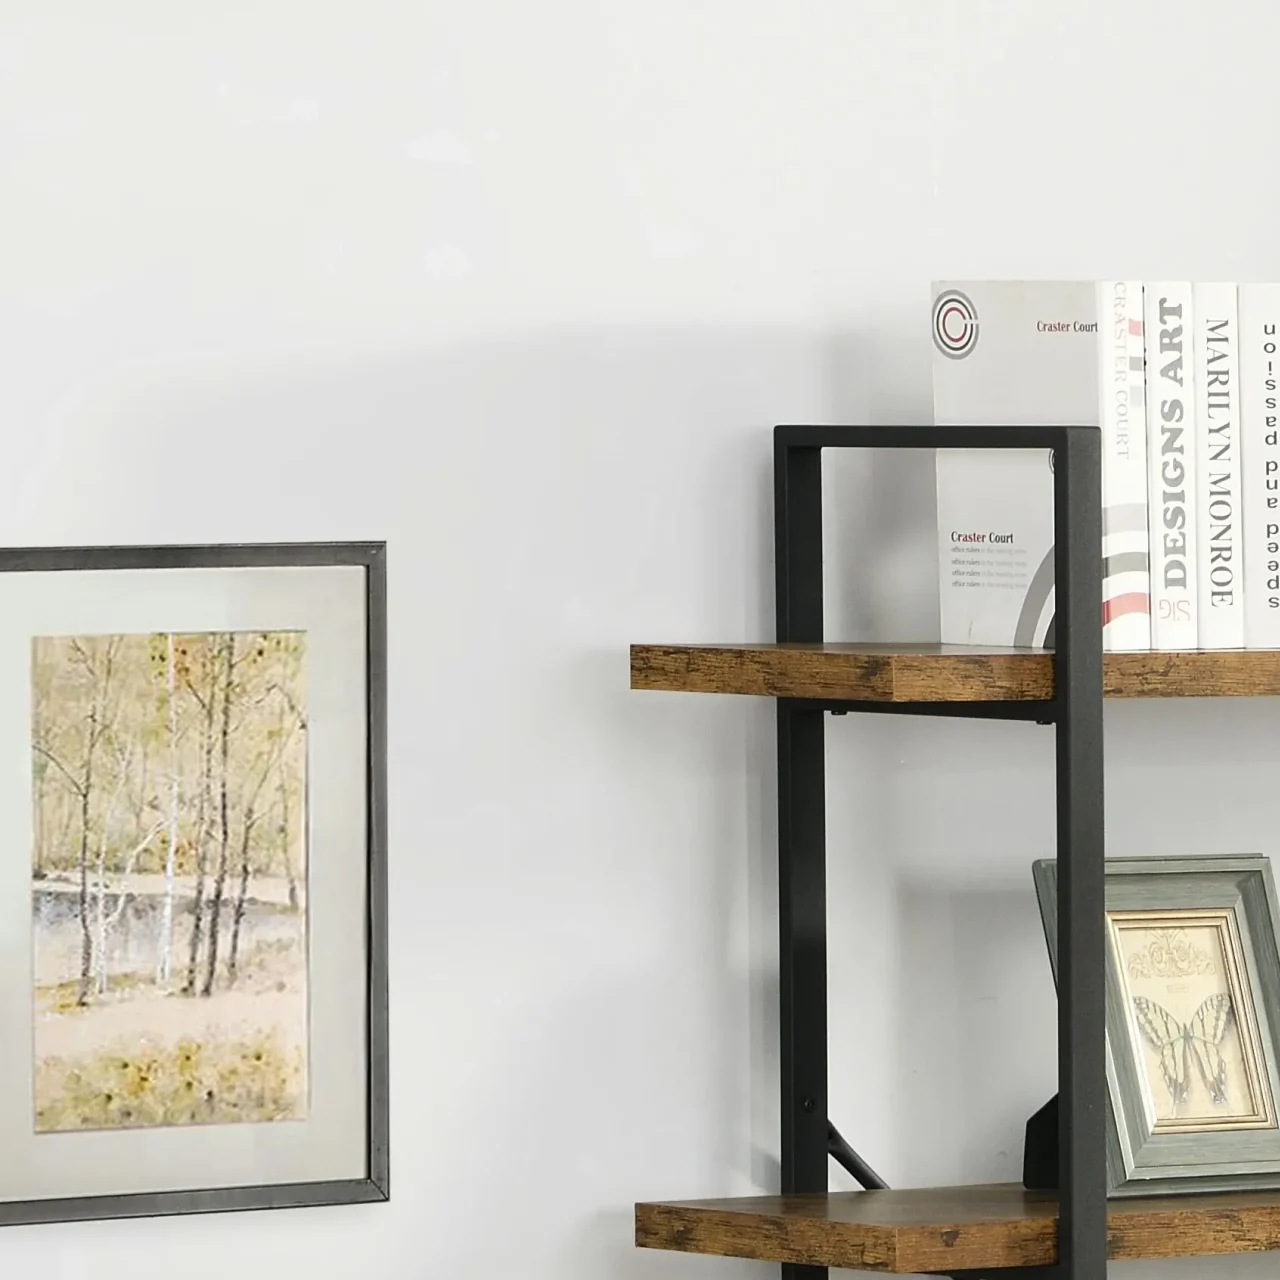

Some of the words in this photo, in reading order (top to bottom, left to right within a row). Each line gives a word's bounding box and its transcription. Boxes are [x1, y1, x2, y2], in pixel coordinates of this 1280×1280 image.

[1036, 320, 1071, 333] Craster
[1073, 320, 1098, 333] Court
[1113, 282, 1127, 384] CRASTER
[1158, 297, 1184, 388] ART
[1116, 389, 1129, 460] COURT
[1206, 318, 1231, 462] MARILYN
[951, 530, 986, 543] Craster
[989, 531, 1014, 544] Court
[1160, 398, 1187, 590] DESIGNS
[1208, 472, 1234, 608] MONROE
